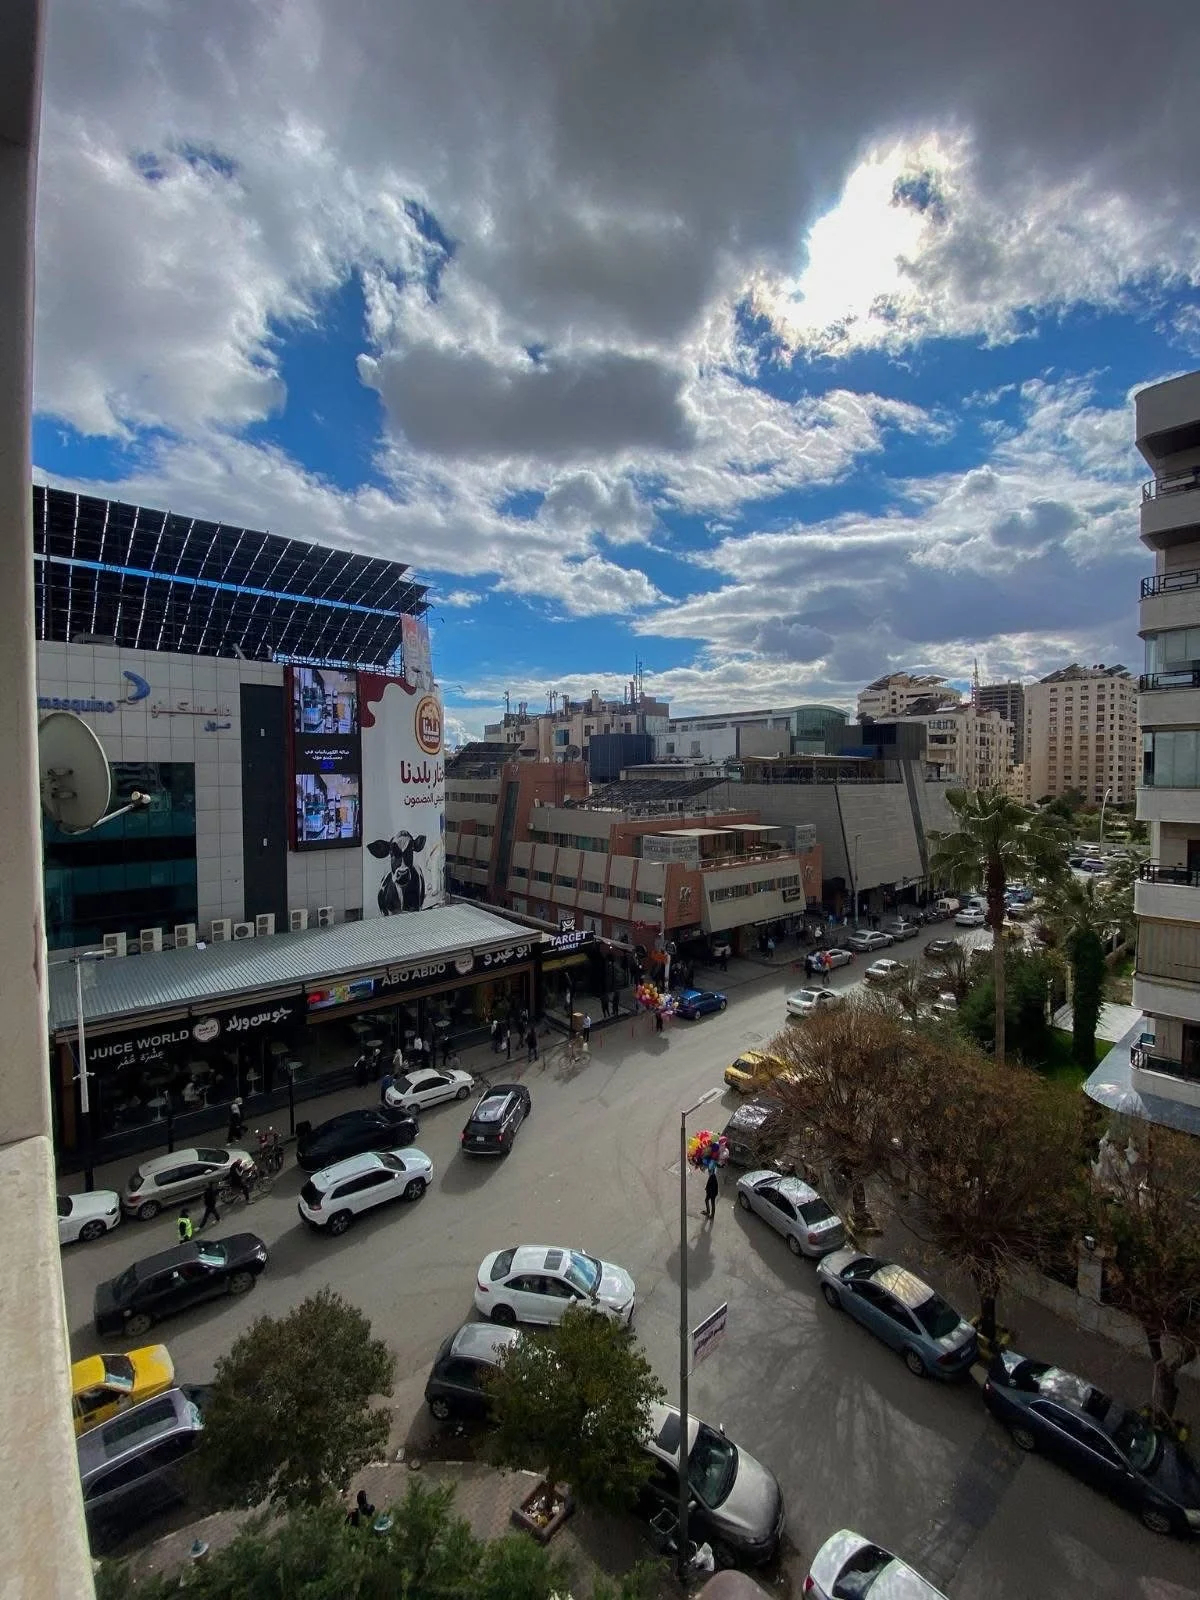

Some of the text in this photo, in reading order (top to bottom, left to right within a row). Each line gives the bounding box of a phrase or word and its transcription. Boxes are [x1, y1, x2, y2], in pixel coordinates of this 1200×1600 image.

[400, 760, 431, 789] بلدنا
[550, 930, 588, 947] TARGET
[381, 962, 447, 988] ABO ABDO
[89, 1029, 190, 1061] JUICE WORLD
